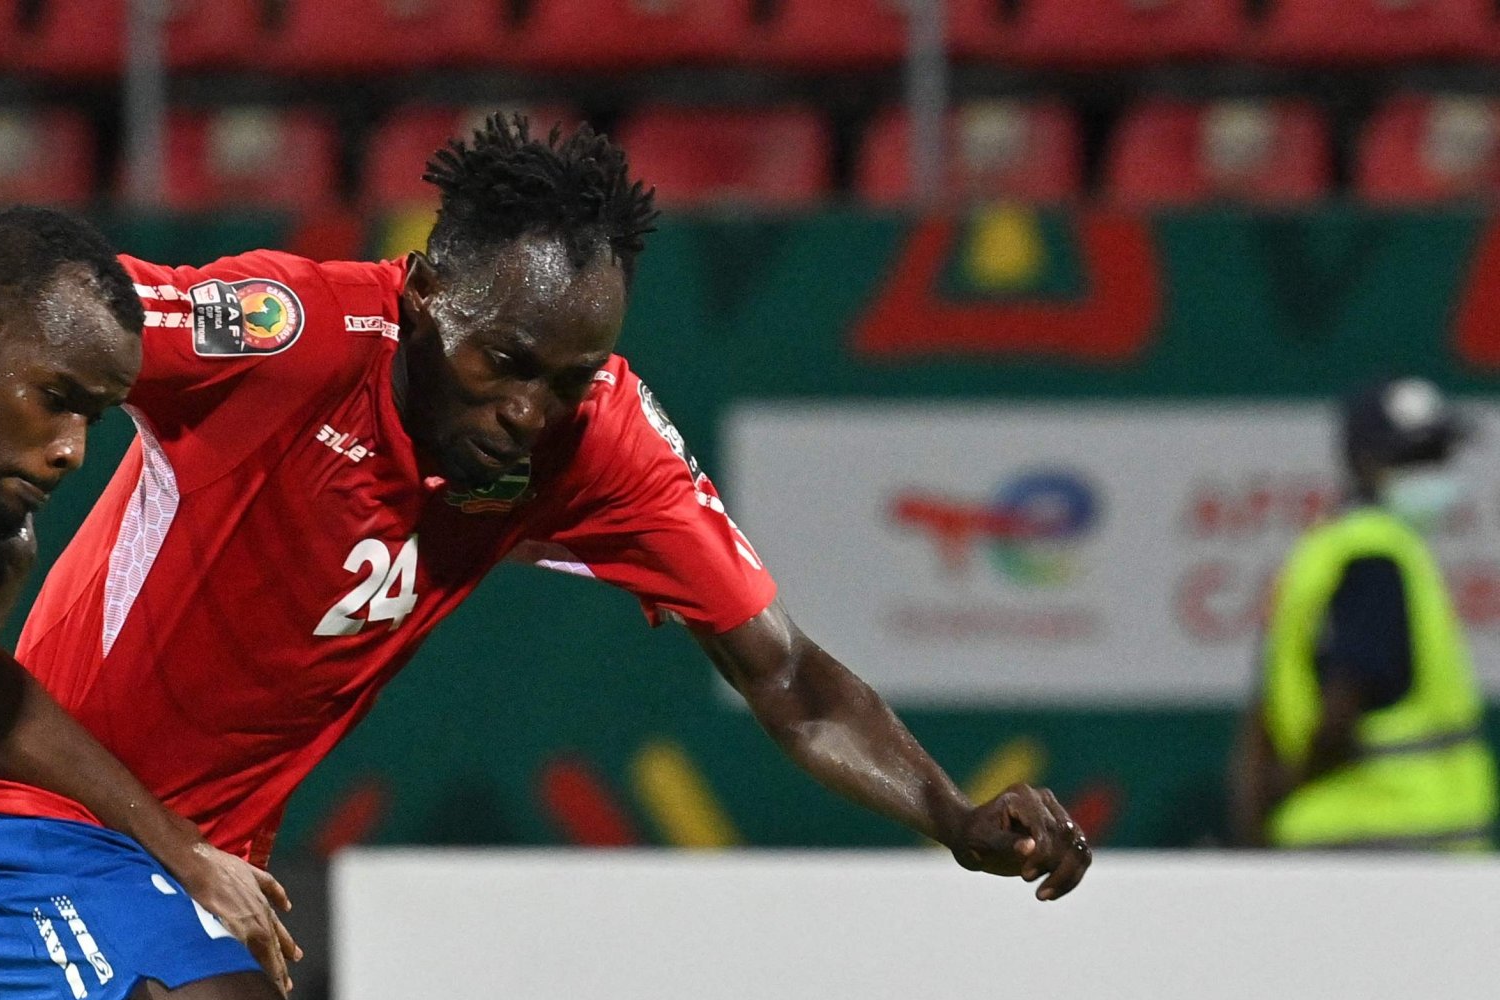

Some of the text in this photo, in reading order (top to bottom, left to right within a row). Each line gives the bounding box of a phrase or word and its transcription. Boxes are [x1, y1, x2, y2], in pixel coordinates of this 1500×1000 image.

[214, 305, 223, 329] AFRICA
[225, 293, 240, 338] CAF
[266, 286, 297, 343] CAMEROON 2021
[312, 532, 418, 636] 24
